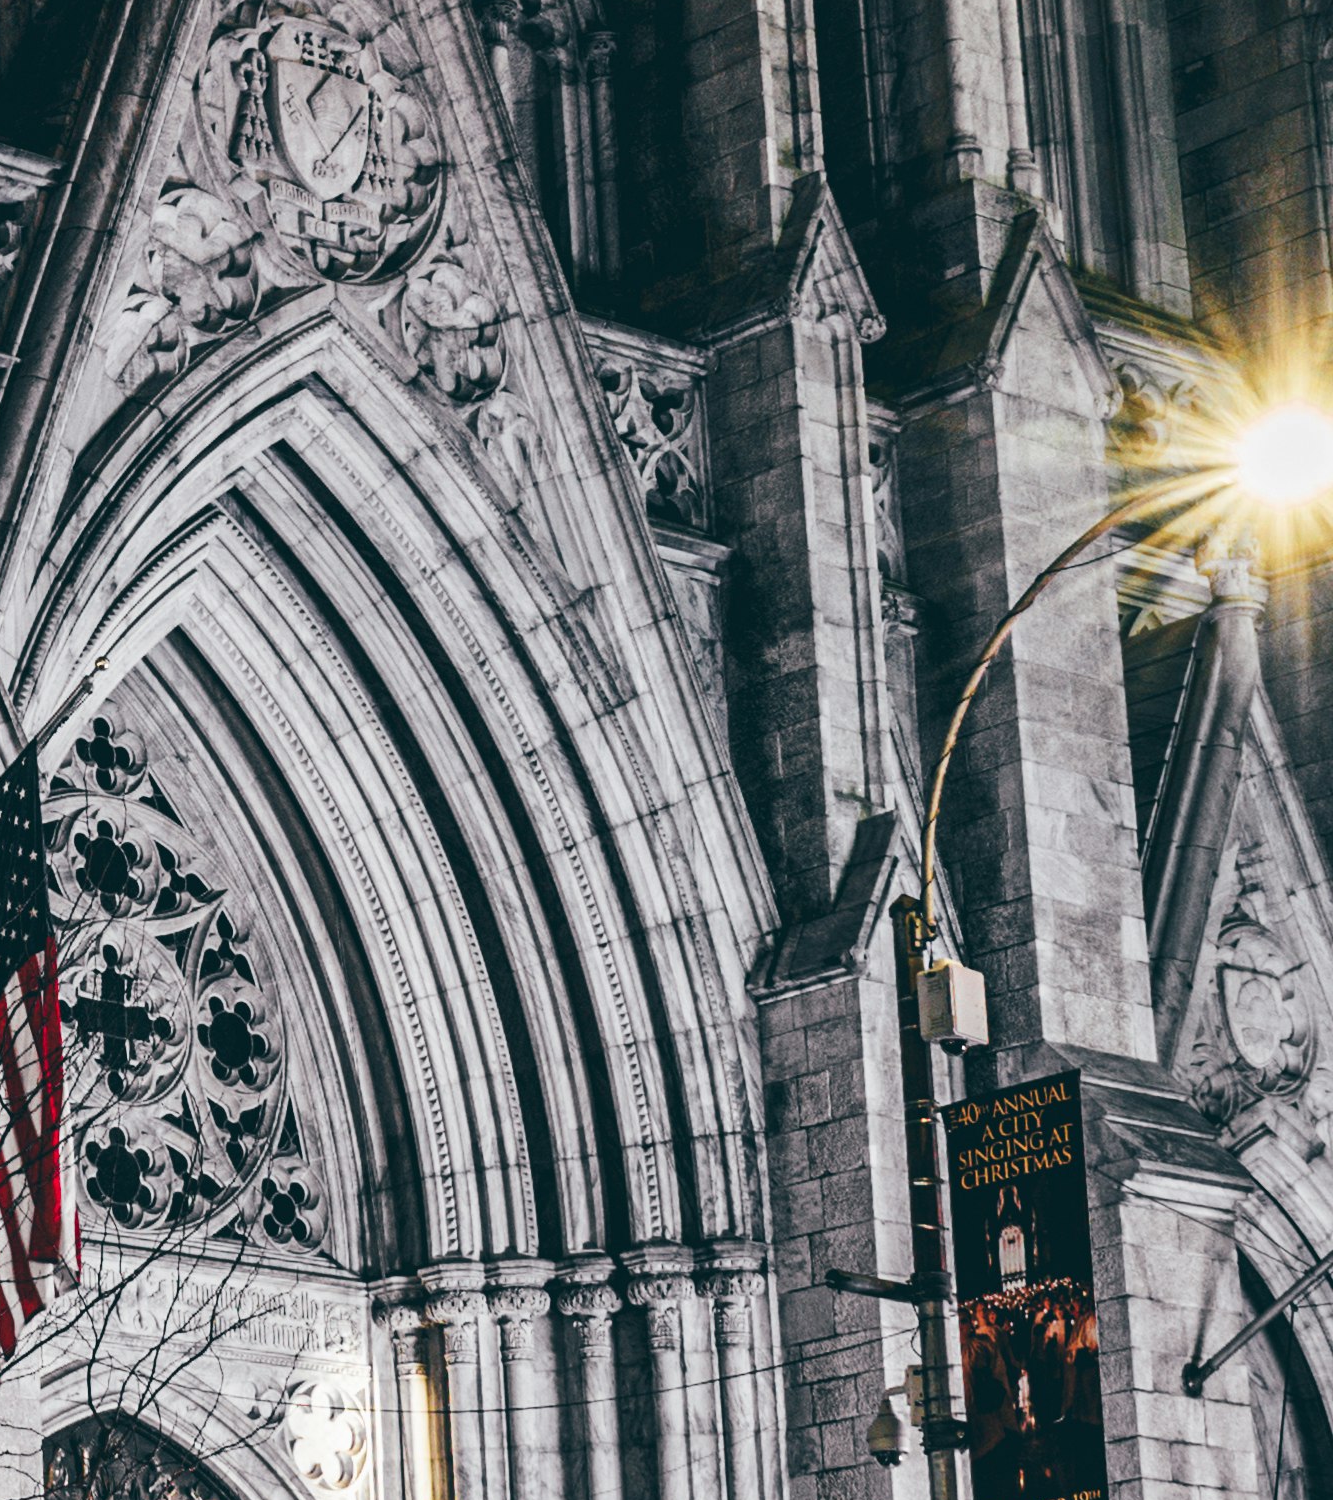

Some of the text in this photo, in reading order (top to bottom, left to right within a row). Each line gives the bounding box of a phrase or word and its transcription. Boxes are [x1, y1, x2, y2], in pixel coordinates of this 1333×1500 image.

[993, 1083, 1072, 1118] ANNUAL
[981, 1109, 1044, 1142] A CITY
[958, 1123, 1073, 1170] SINGING AT
[961, 1145, 1072, 1190] CHRISTMAS
